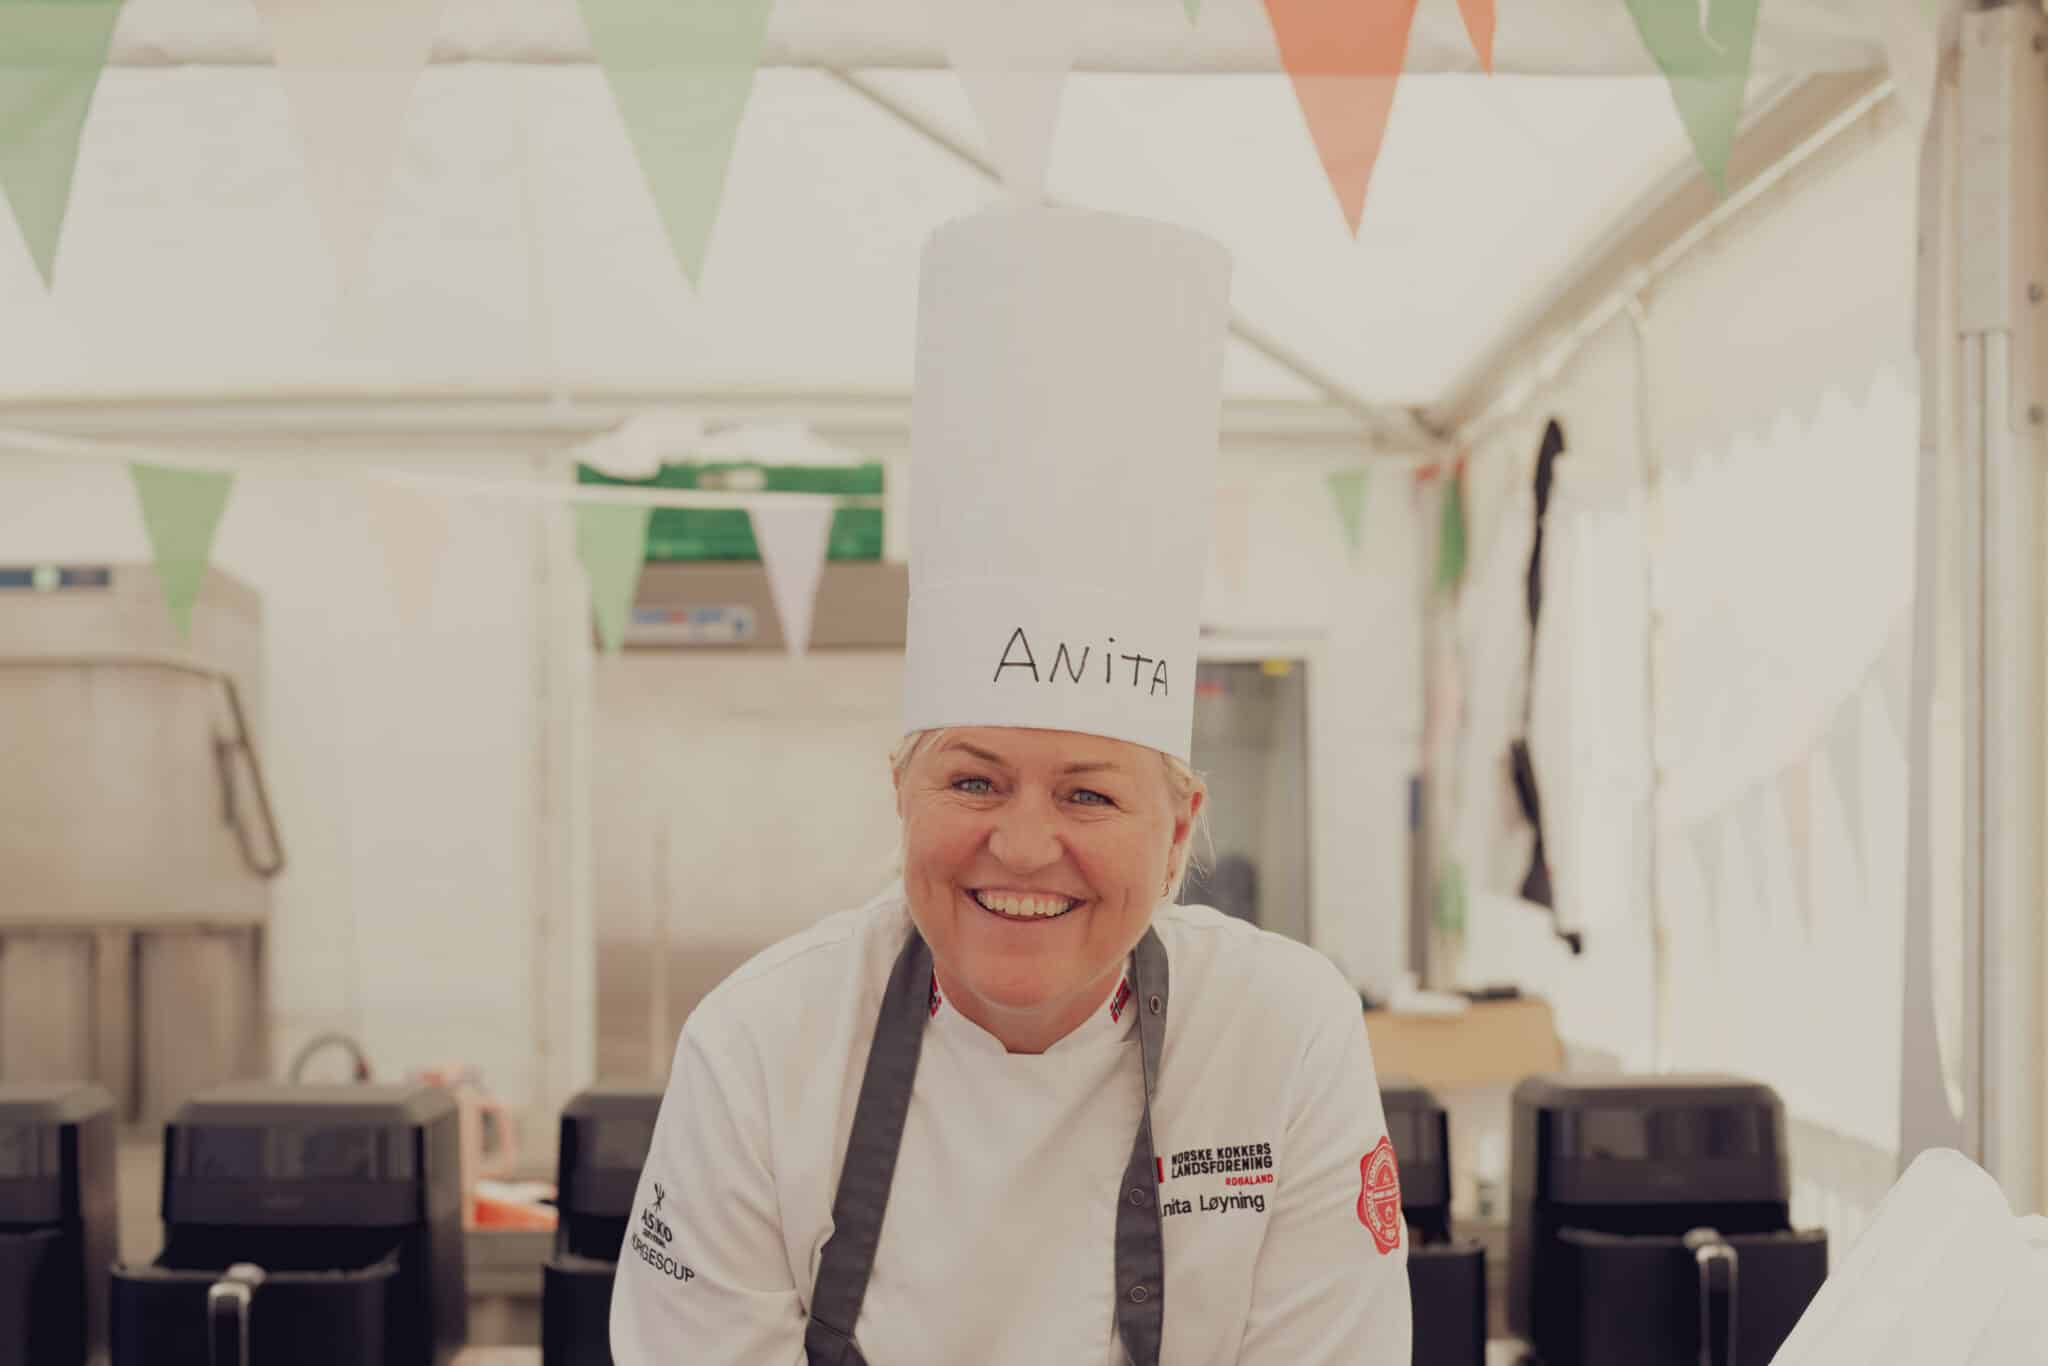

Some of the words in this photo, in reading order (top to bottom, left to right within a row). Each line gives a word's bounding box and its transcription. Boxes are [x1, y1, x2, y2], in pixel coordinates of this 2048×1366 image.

[1171, 1148, 1213, 1165] NORSKE
[1216, 1142, 1272, 1160] KOKKERS
[1171, 1155, 1273, 1179] LANDSFORENING
[1225, 1174, 1274, 1186] ROGALAND
[1161, 1198, 1192, 1217] nita
[1199, 1192, 1265, 1213] Løyning
[641, 1208, 673, 1243] ASKO
